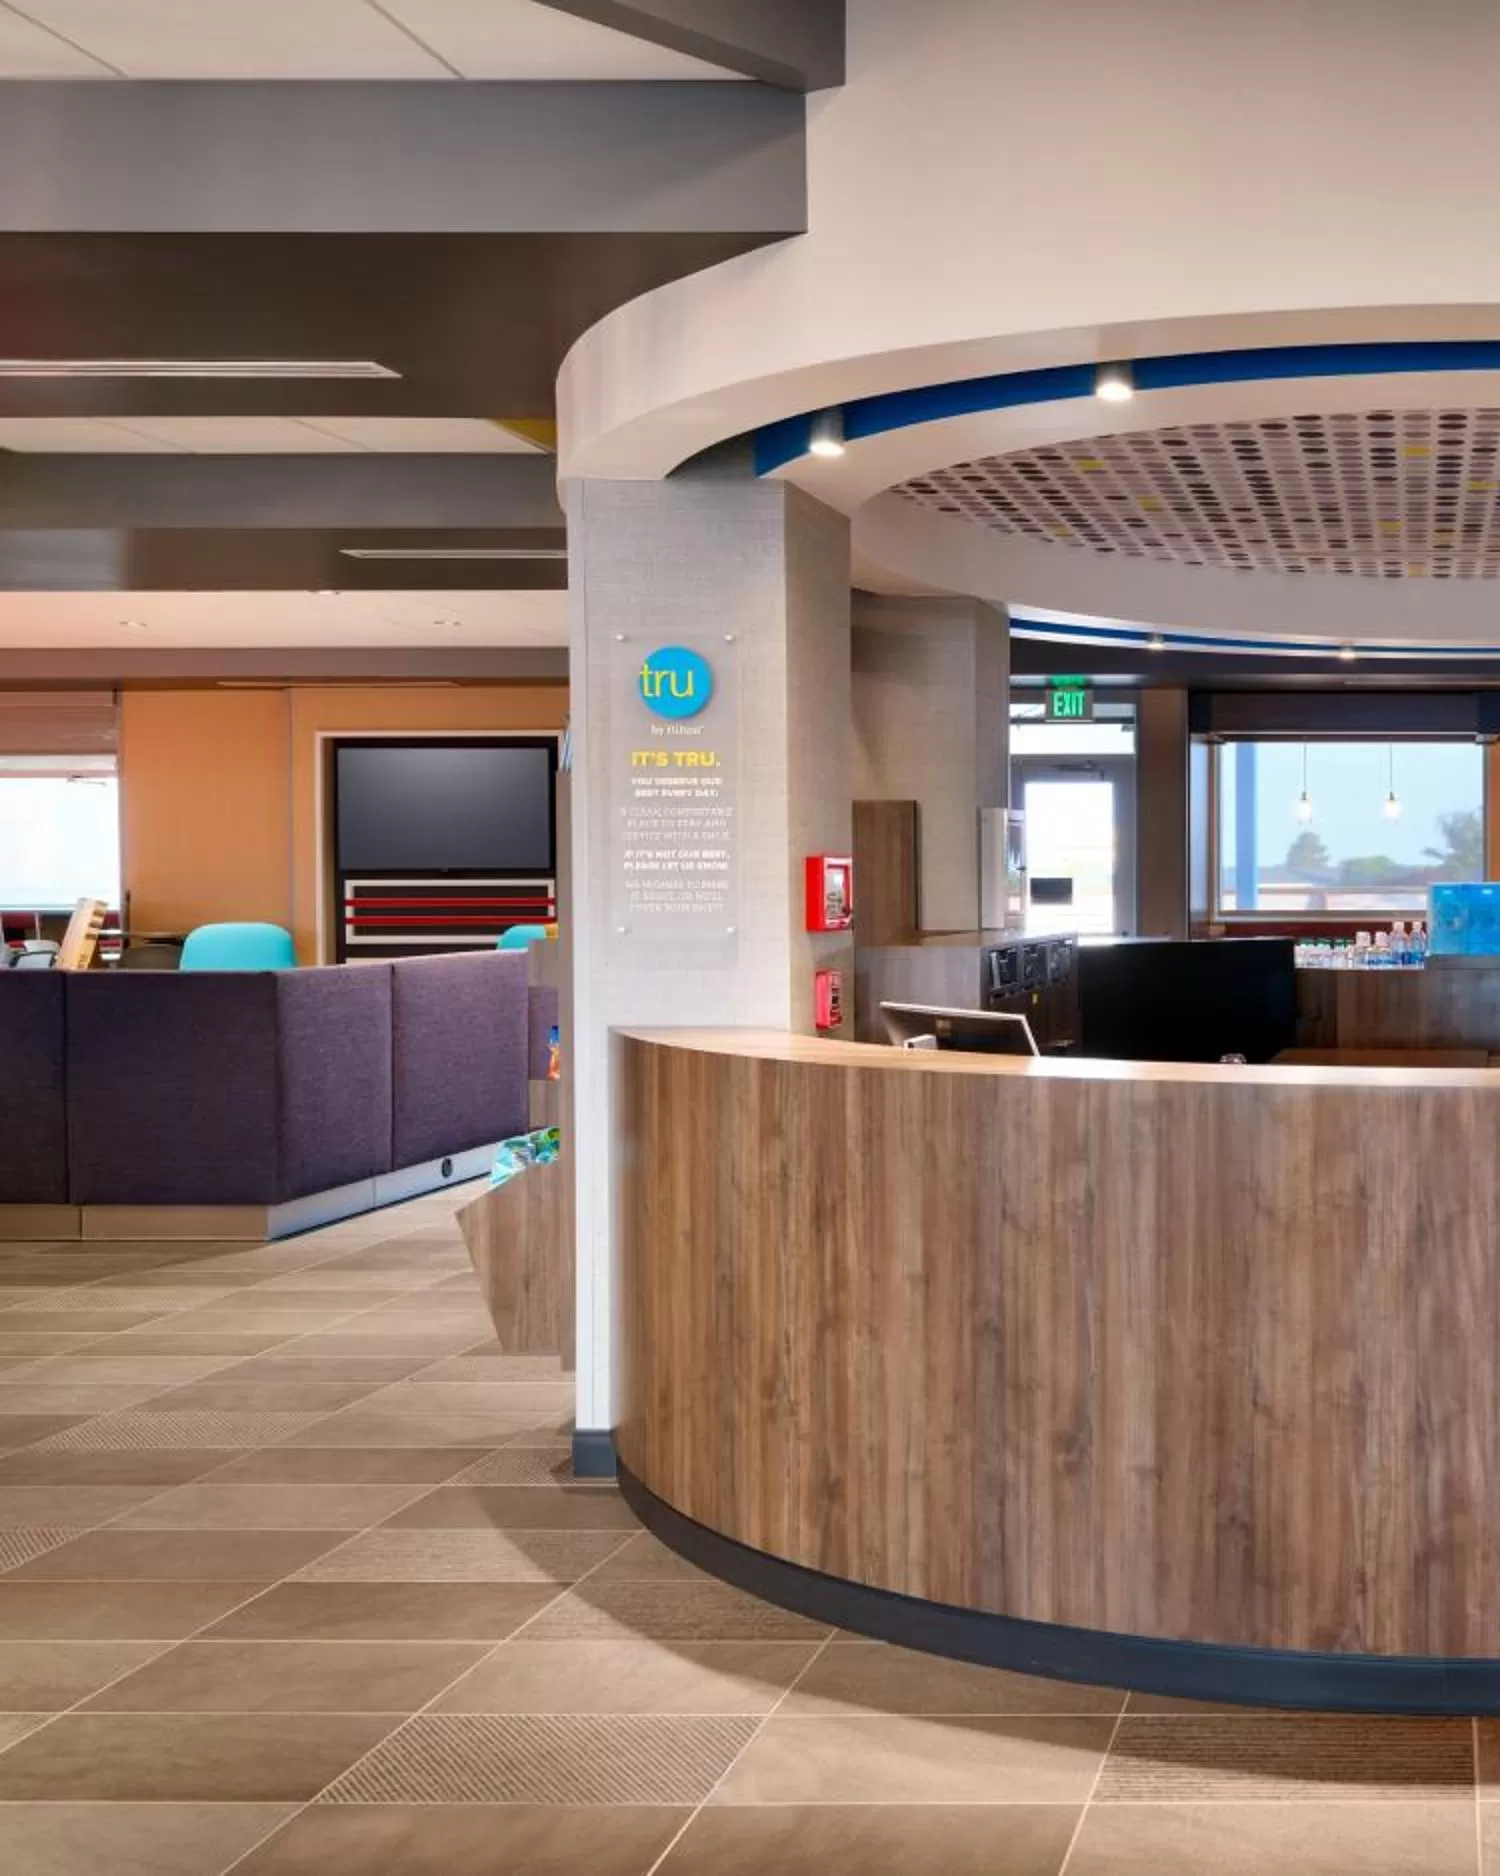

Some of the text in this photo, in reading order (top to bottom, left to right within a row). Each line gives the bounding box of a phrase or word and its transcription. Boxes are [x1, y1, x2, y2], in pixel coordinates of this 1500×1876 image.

[640, 660, 694, 698] tru
[1053, 691, 1085, 717] EXIT
[631, 751, 721, 767] IT'S TRU.
